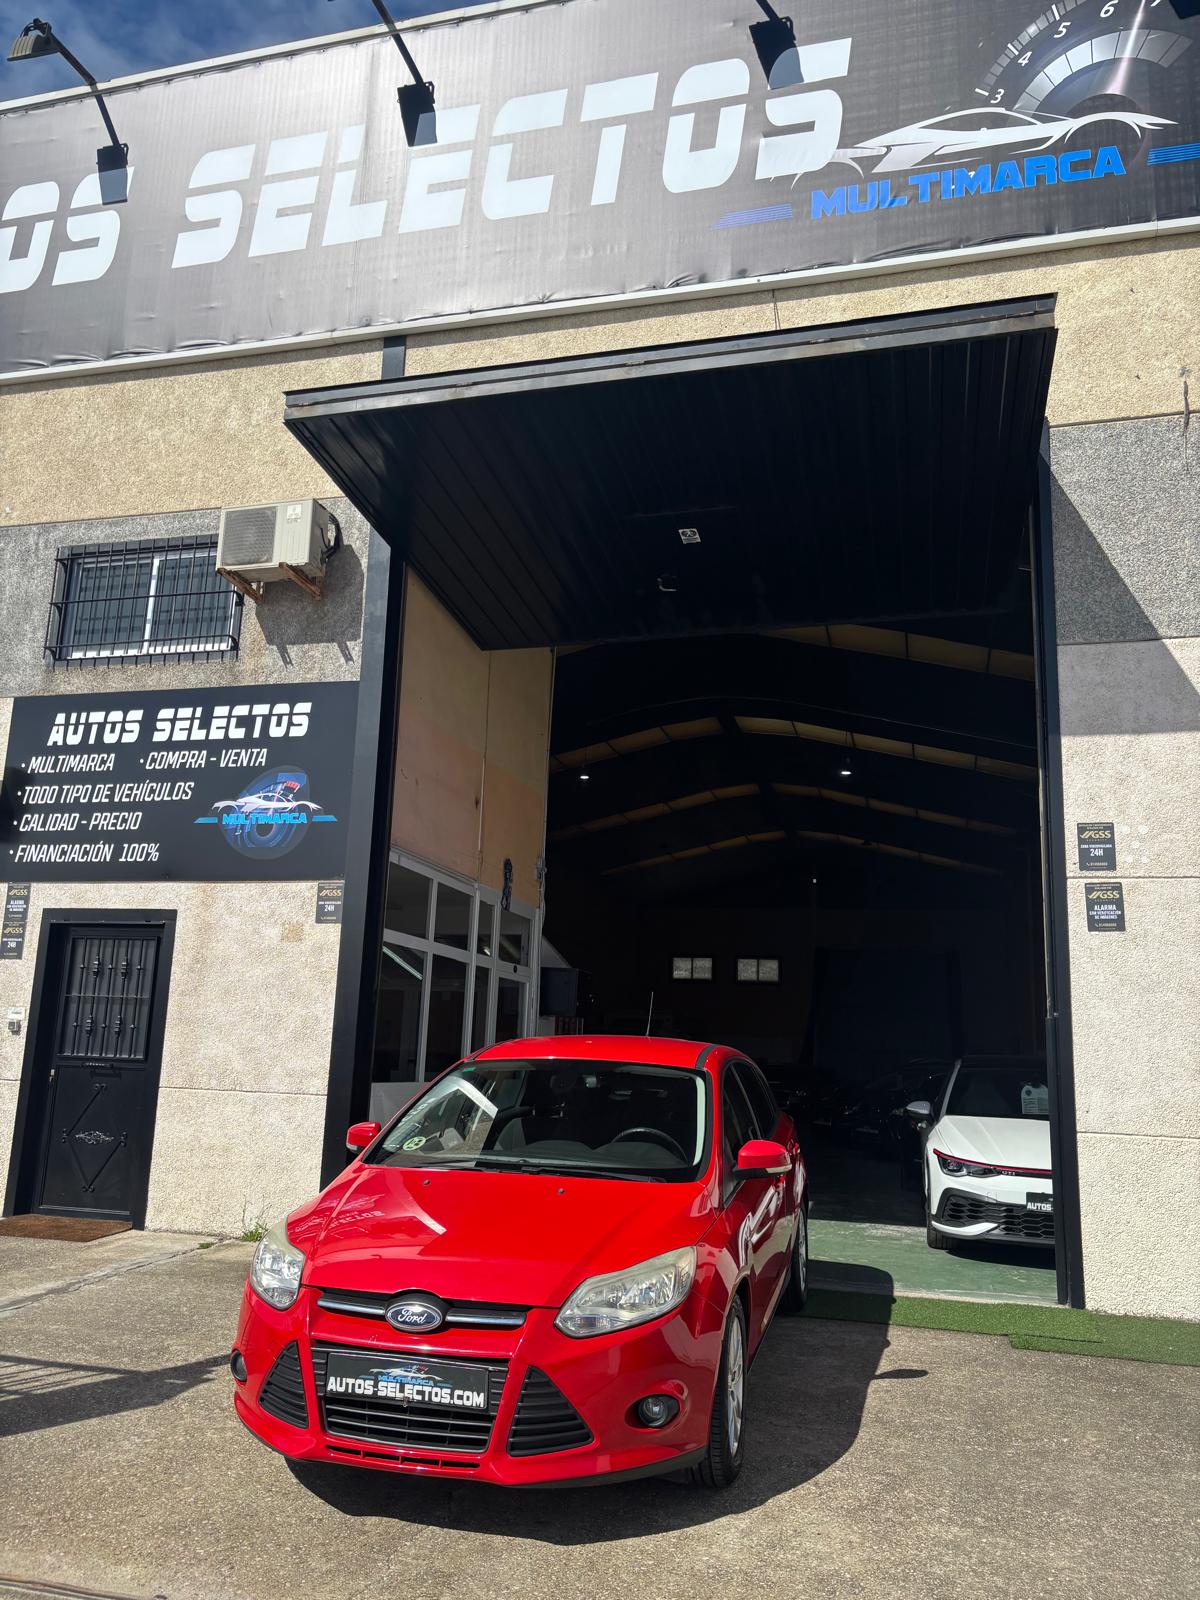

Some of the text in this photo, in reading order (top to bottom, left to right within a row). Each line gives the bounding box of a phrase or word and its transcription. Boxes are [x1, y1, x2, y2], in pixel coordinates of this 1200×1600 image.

[1100, 0, 1118, 18] 6
[1053, 22, 1071, 38] 5
[1017, 51, 1032, 67] 4
[990, 88, 1005, 103] 3
[171, 37, 852, 269] SELECTOS
[810, 145, 1127, 220] MULTIMARCA
[46, 702, 312, 746] AUTOS SELECTOS
[27, 753, 115, 774] MULTIMARCA
[145, 750, 207, 770] COMPRA
[219, 748, 267, 768] VENTA
[22, 780, 195, 805] TODO TIPO DE VEHÍCULOS
[19, 813, 79, 832] CALIDAD
[88, 811, 142, 831] PRECIO
[222, 812, 308, 825] MULTIMARCA
[14, 841, 160, 863] FINANCIACIÓN 100%
[1090, 848, 1104, 857] 24H
[398, 1309, 427, 1324] Ford
[327, 1376, 485, 1408] AUTOS-SELECTOS.COM
